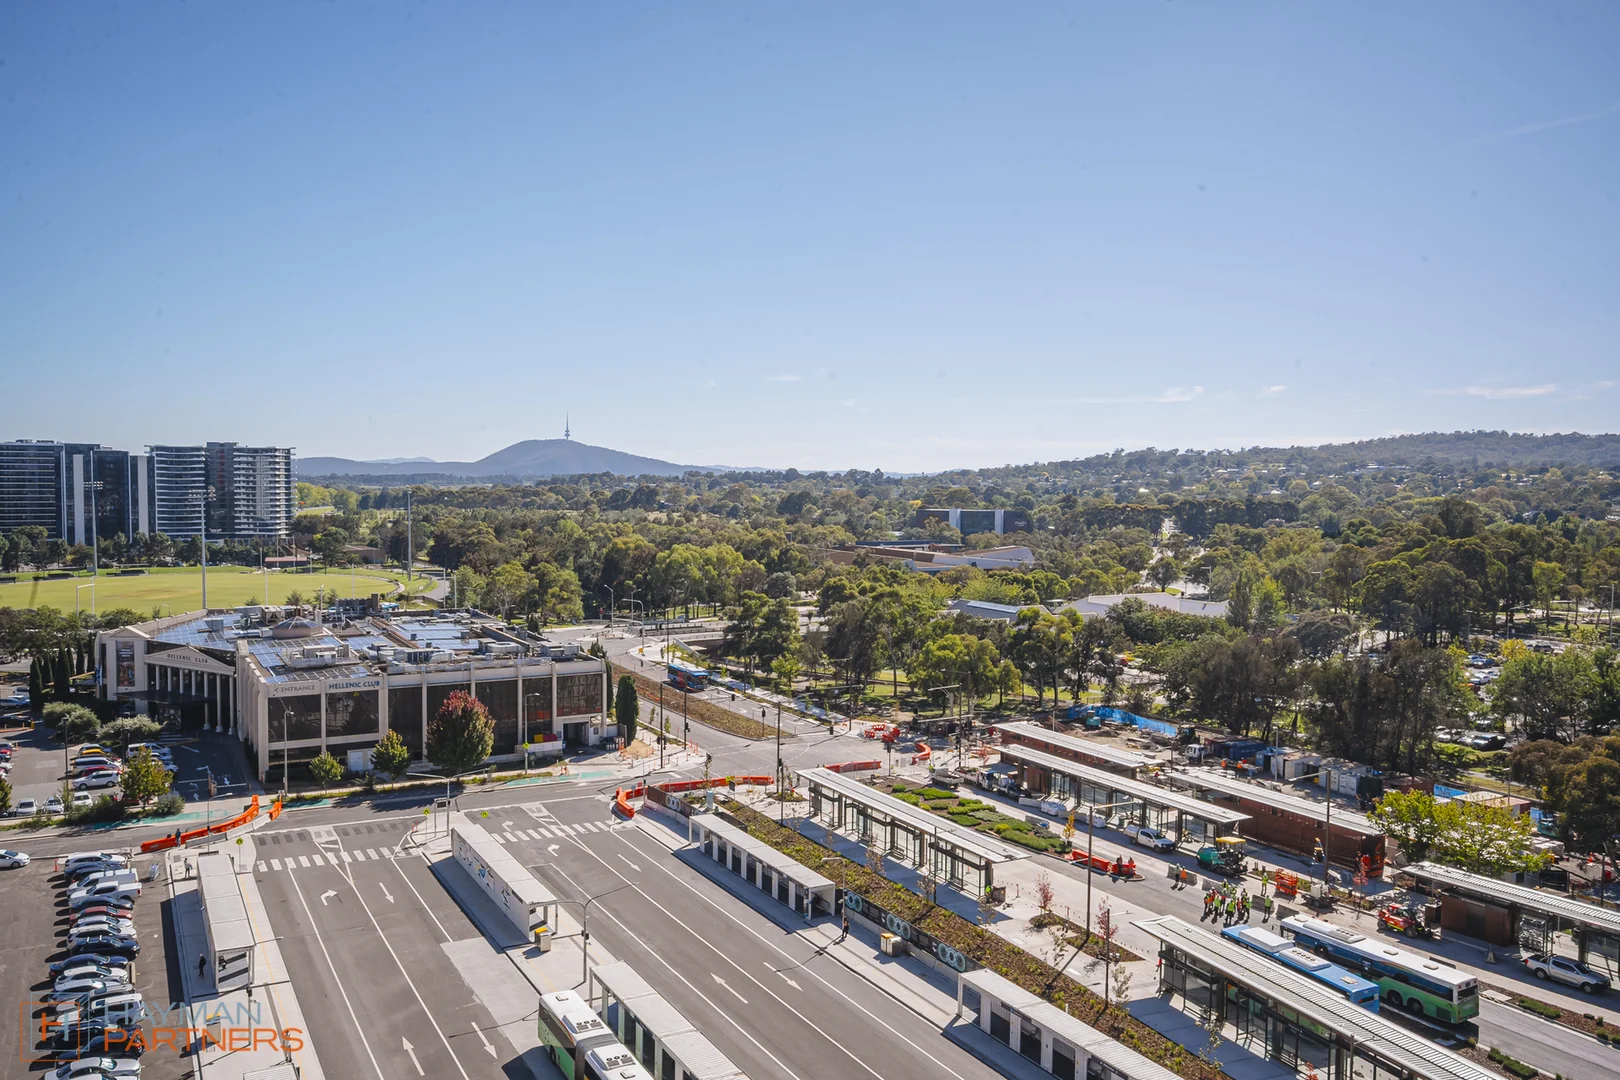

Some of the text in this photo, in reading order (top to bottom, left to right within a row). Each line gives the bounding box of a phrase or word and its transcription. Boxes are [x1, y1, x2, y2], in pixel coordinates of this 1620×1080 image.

[167, 653, 191, 661] HELLENIC
[281, 685, 315, 693] ENTRANCE
[328, 680, 380, 690] HELLENIC CLUB
